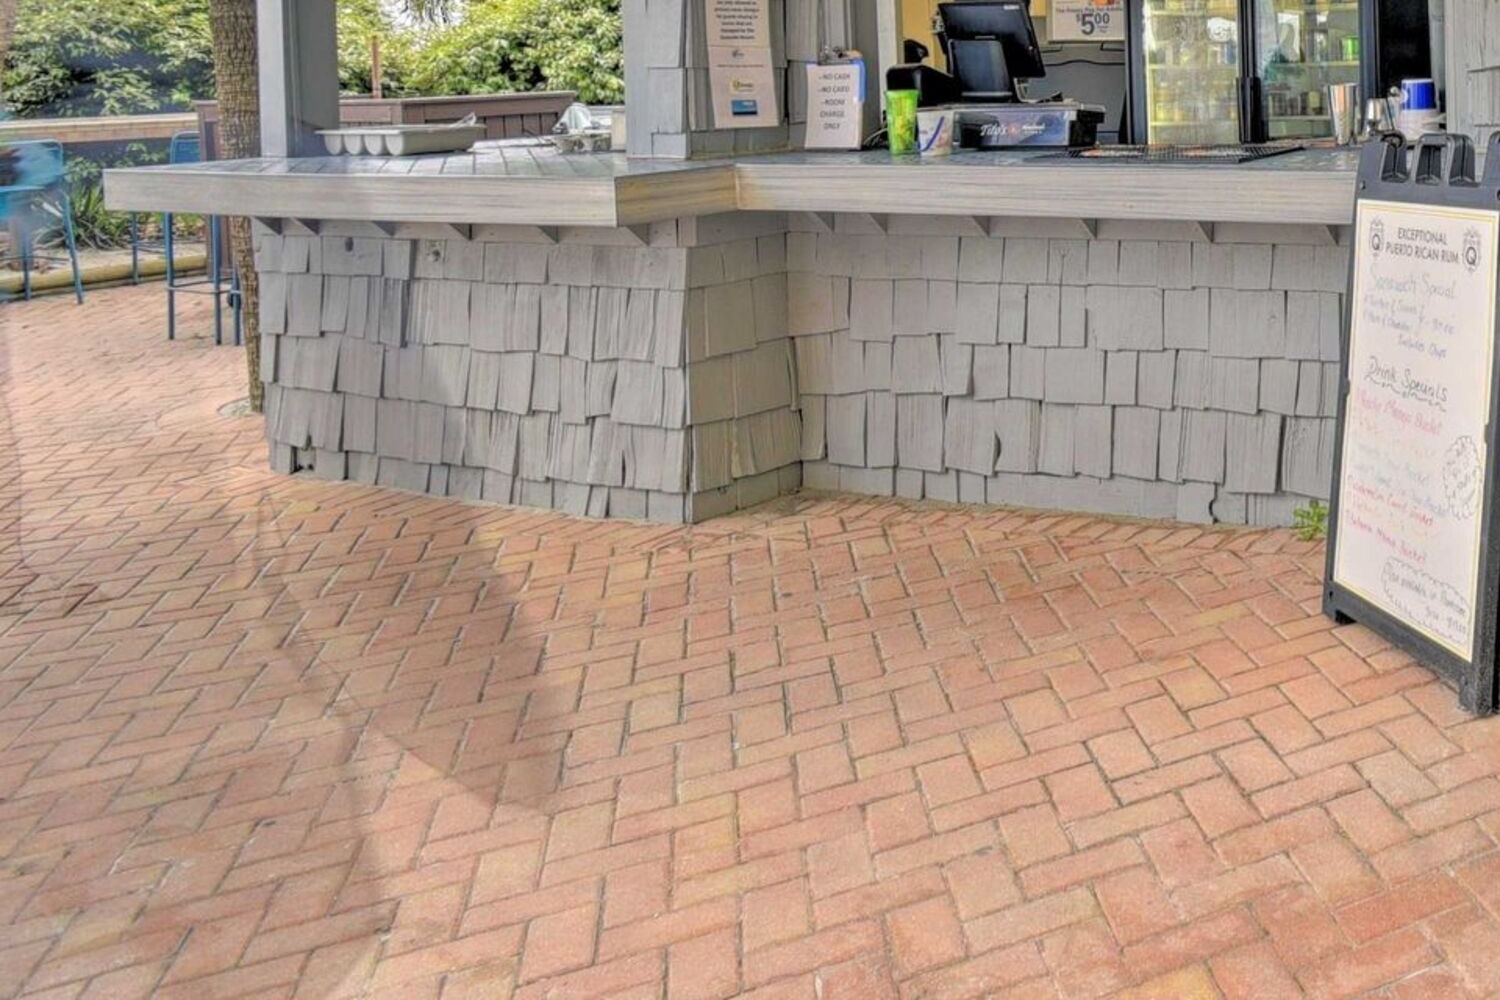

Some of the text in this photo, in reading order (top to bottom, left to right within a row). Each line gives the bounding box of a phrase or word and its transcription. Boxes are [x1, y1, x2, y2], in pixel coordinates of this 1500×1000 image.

[1398, 227, 1448, 245] EXCEPTIONAL
[1385, 241, 1459, 263] PUERTO RICAN RUM
[1466, 246, 1477, 266] Q
[1369, 356, 1448, 402] Drink Specials
